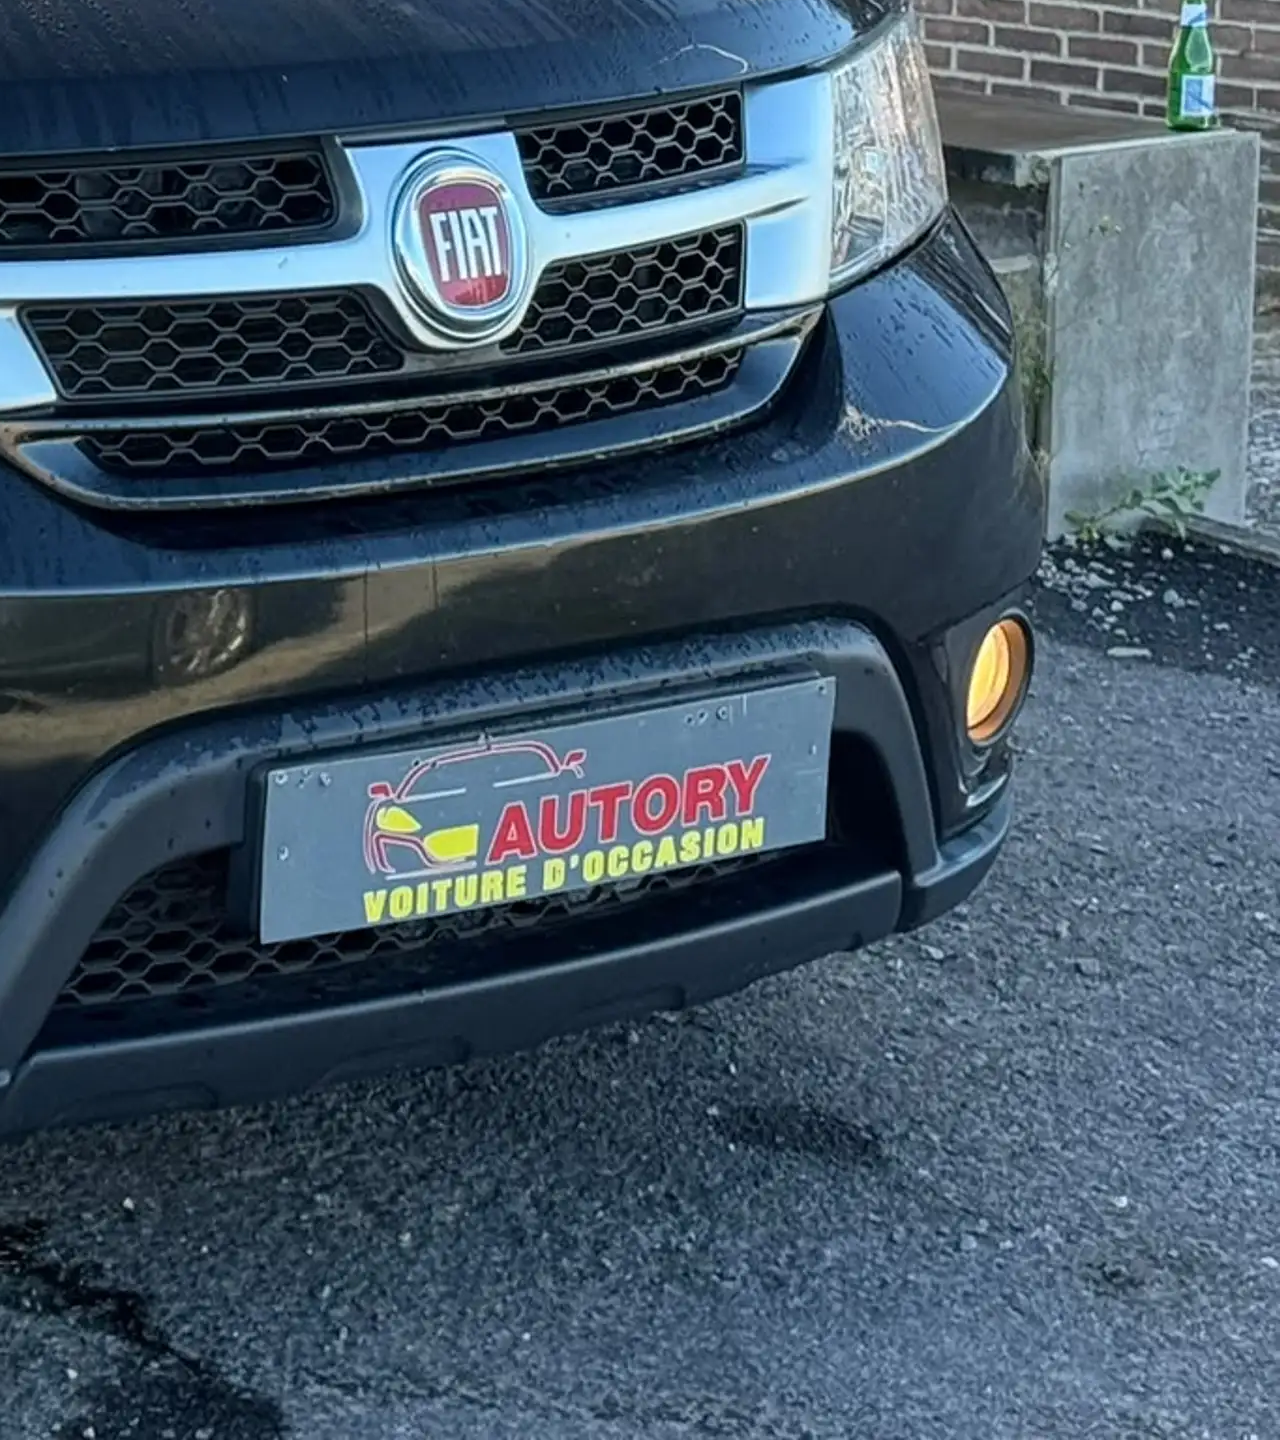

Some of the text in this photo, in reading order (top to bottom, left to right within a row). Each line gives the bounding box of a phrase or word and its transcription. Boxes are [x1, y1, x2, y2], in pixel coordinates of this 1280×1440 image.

[429, 206, 502, 282] FIAT
[485, 754, 772, 864] AUTORY
[363, 816, 765, 923] VOITURE D'OCCASION
